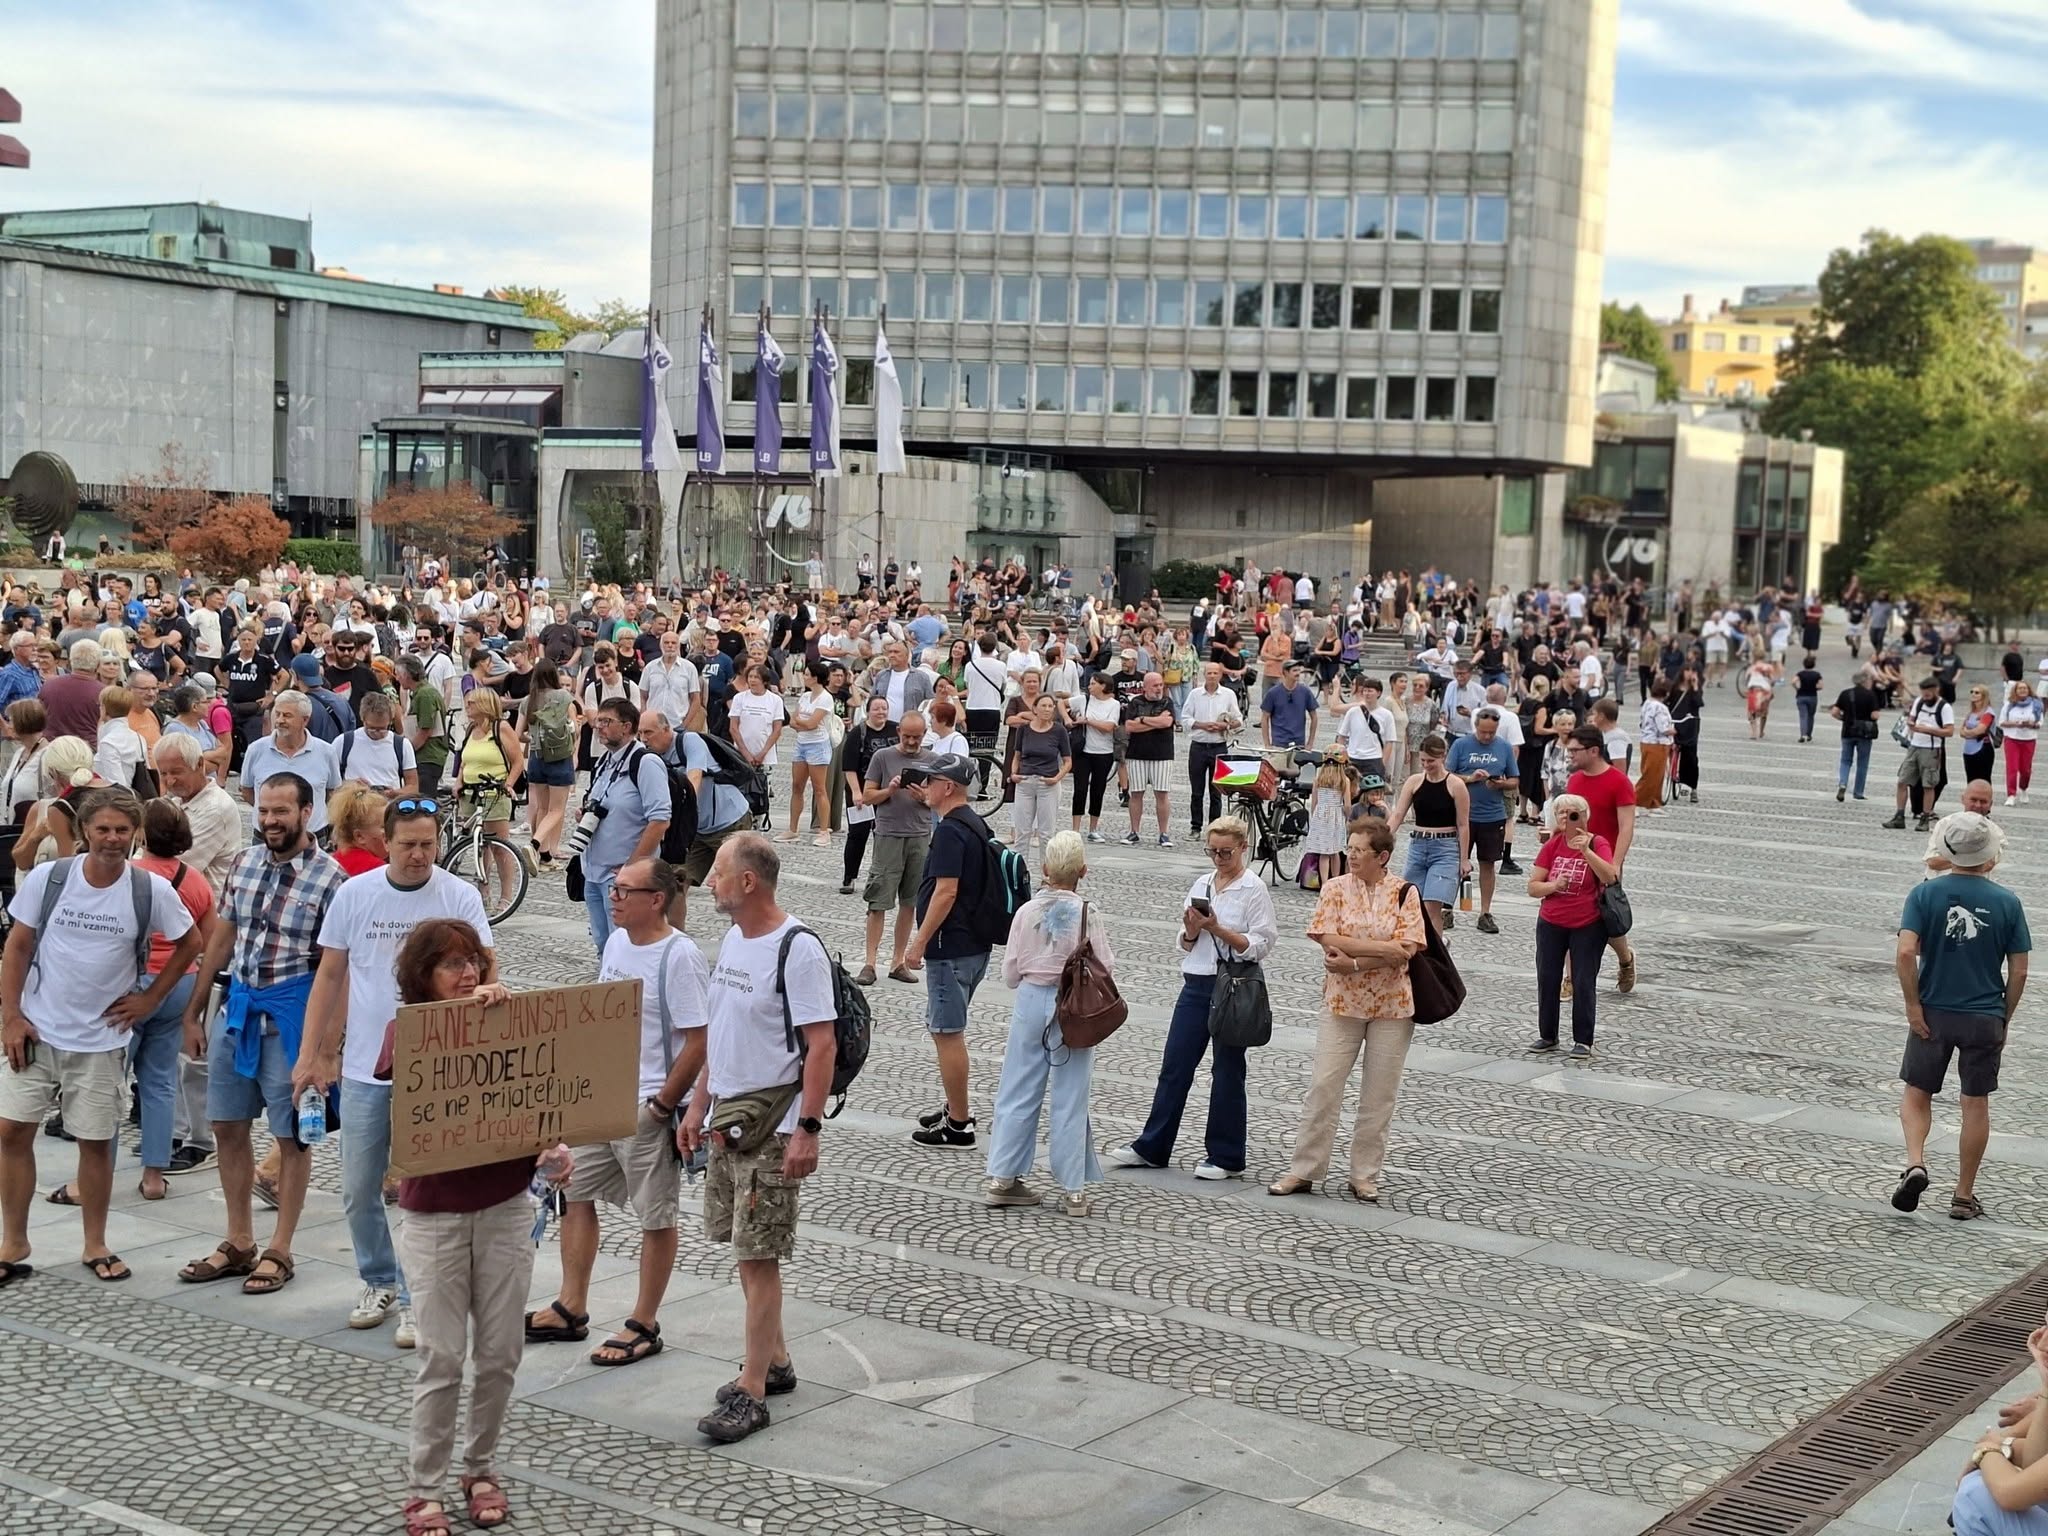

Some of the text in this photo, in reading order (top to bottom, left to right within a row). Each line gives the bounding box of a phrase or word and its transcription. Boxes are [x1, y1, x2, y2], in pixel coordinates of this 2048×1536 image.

[230, 672, 258, 682] BMW
[62, 908, 74, 918] Ne
[54, 917, 124, 934] da mi vzamejo
[372, 920, 385, 929] Ne
[366, 931, 377, 939] da
[380, 931, 392, 939] mi
[578, 990, 596, 1024] &
[406, 1038, 556, 1093] S HUDODELCI
[411, 1101, 435, 1125] se
[445, 1094, 470, 1117] ne
[411, 1132, 433, 1155] se
[441, 1124, 466, 1147] ne
